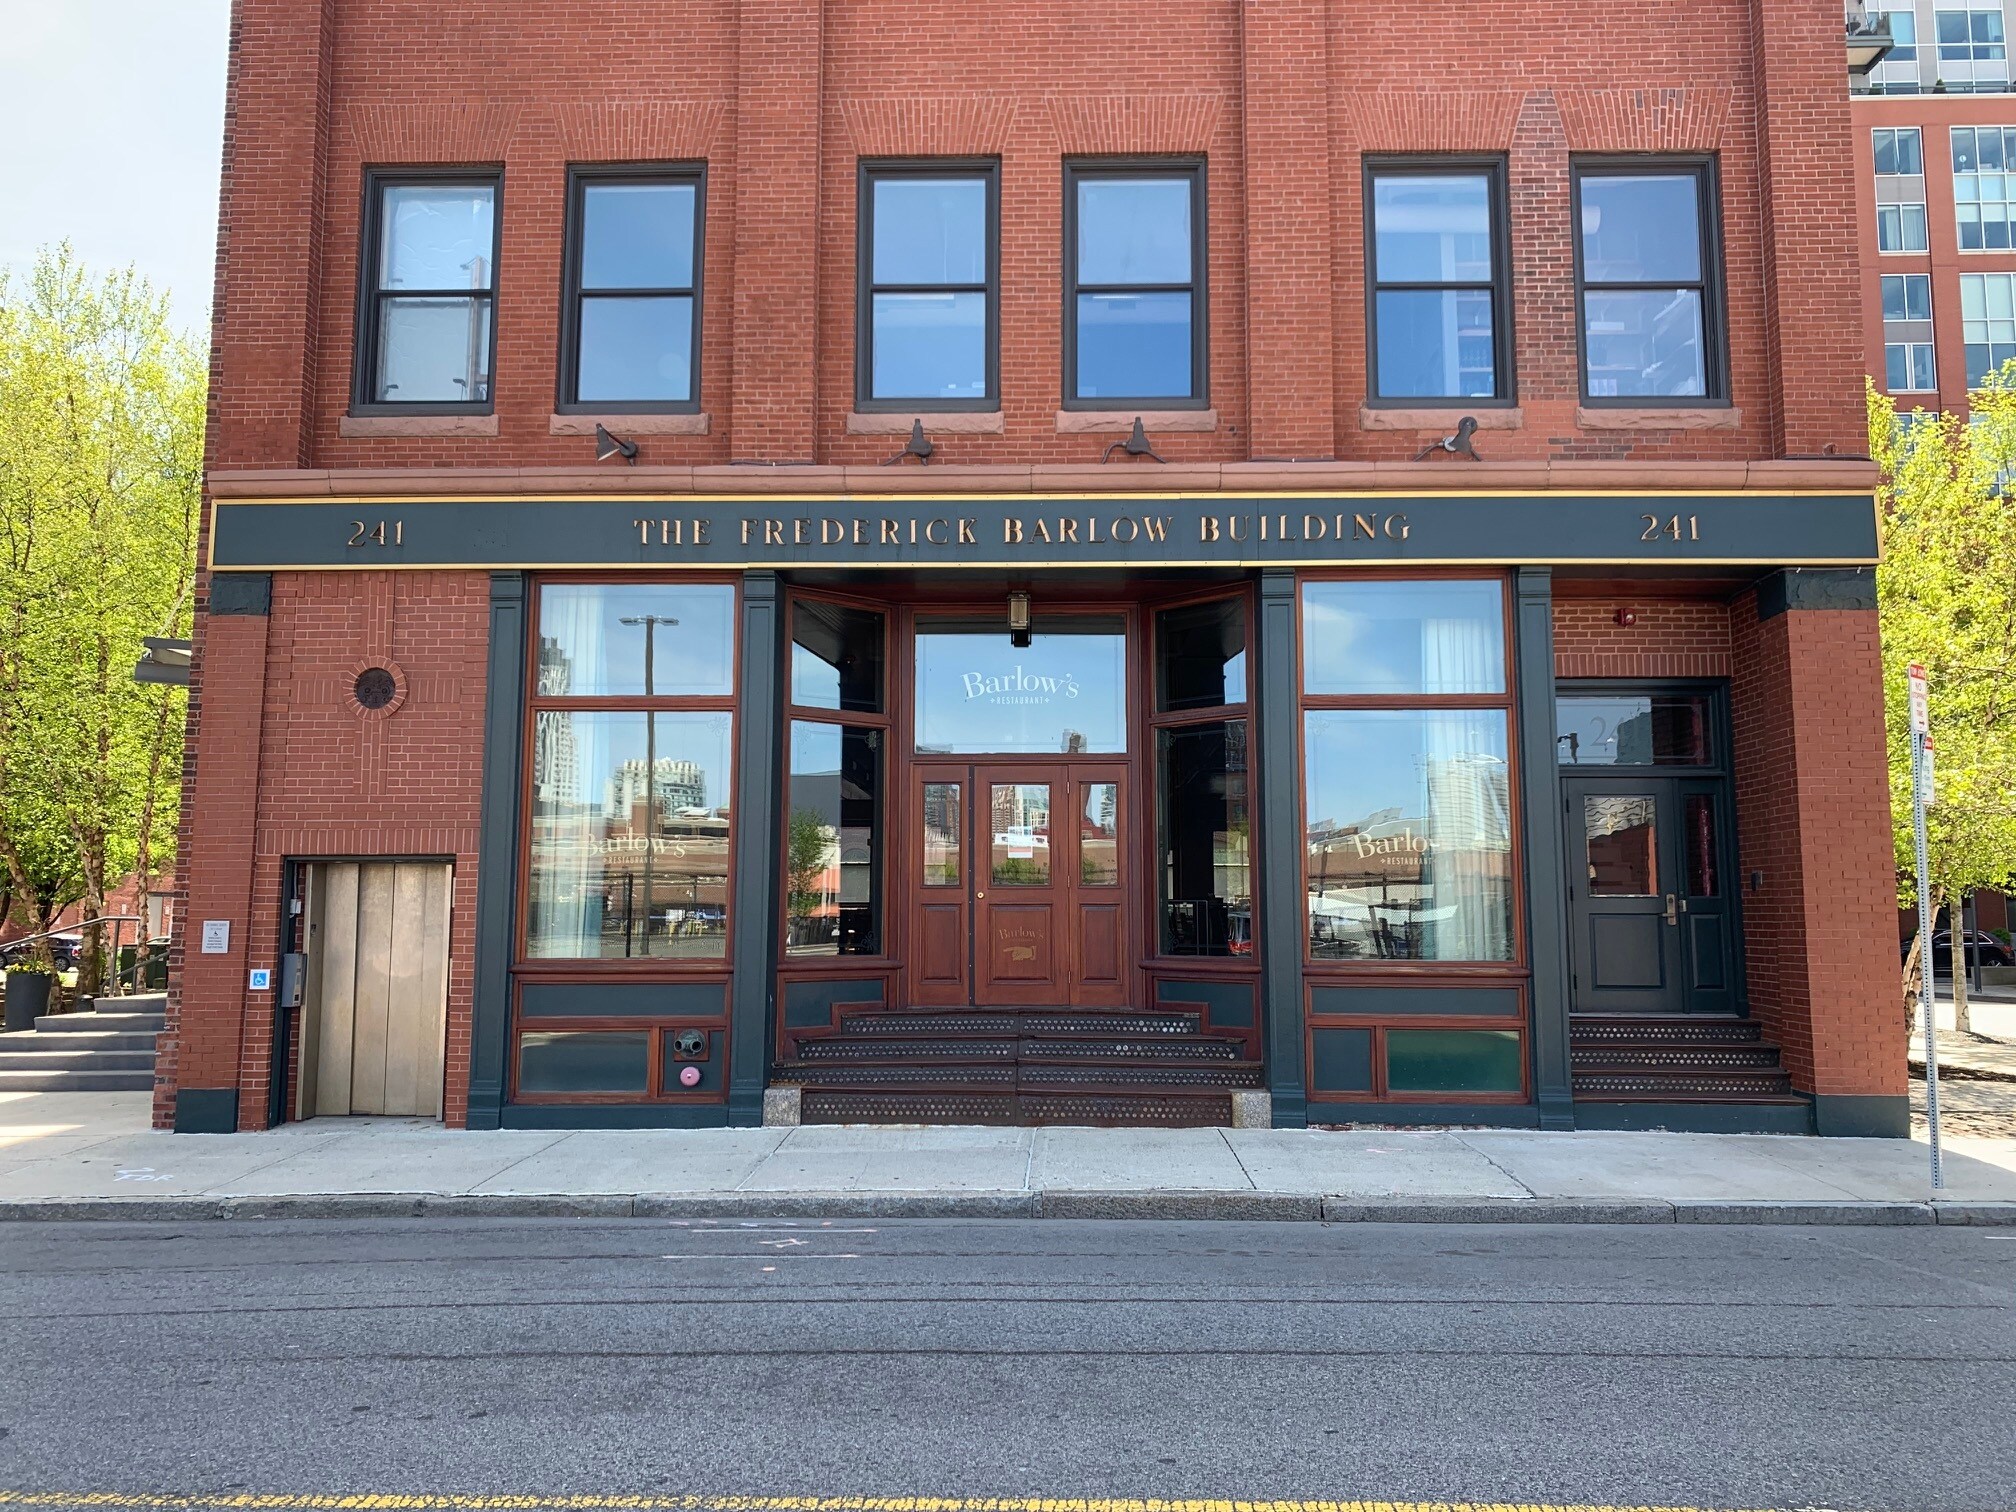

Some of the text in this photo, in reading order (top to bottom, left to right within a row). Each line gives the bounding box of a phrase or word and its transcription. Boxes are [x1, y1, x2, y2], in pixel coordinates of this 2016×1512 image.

[347, 520, 404, 547] 241
[633, 513, 1411, 546] THE FREDERICK BARLOW BUILDING
[1640, 514, 1700, 541] 241
[960, 665, 1080, 699] Barlow's
[996, 696, 1043, 705] RESTAURANT
[1354, 828, 1442, 859] Barlo
[608, 856, 652, 864] RESTAURANT
